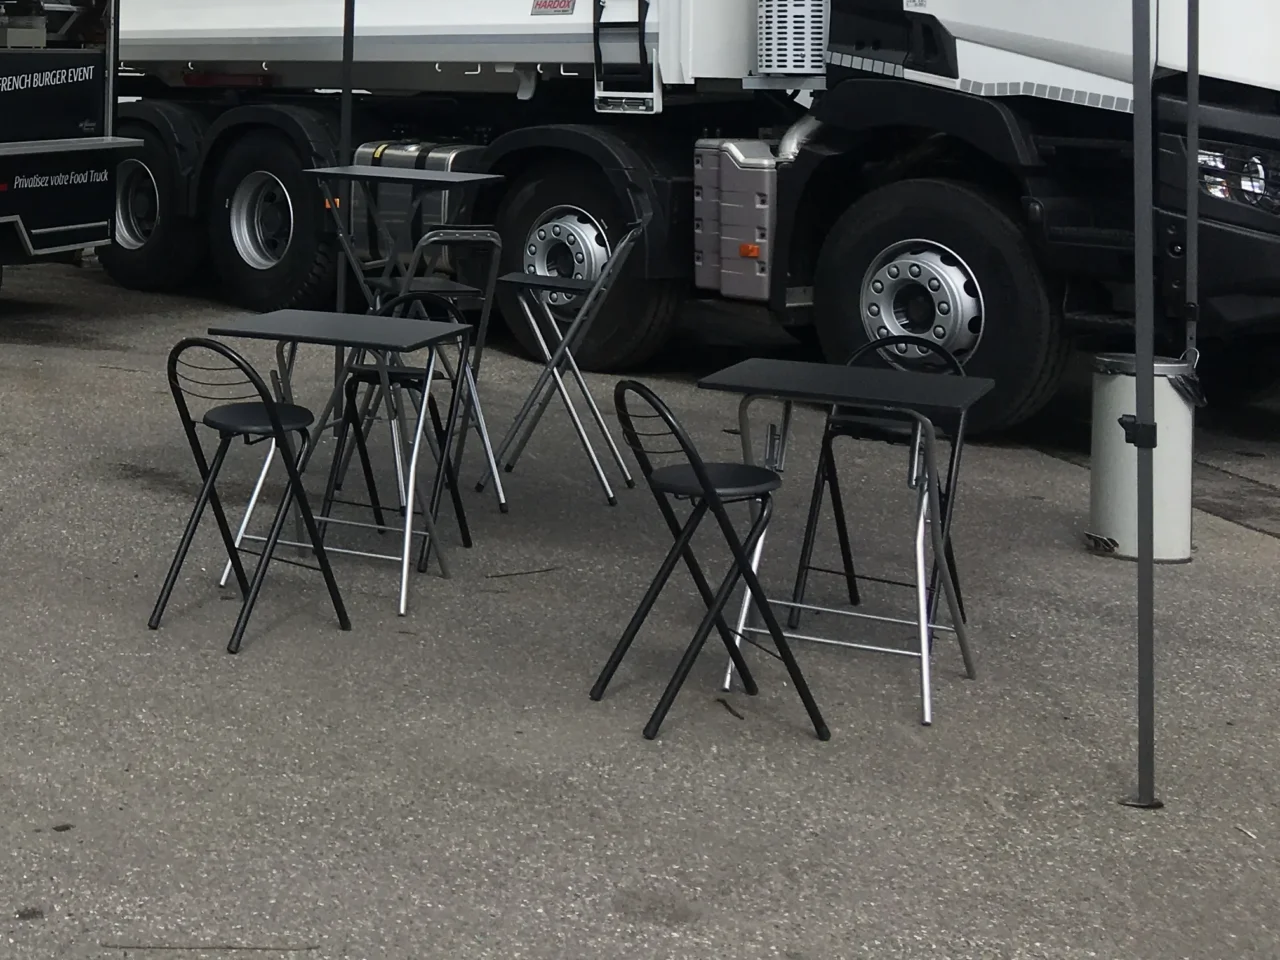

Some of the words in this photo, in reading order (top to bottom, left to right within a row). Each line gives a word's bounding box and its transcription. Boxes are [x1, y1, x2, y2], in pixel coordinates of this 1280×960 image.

[534, 0, 572, 9] HARDOX
[32, 69, 67, 88] BURGER
[67, 65, 95, 83] EVENT
[13, 174, 50, 189] Privatisez
[50, 172, 69, 186] votre
[69, 170, 89, 184] Food
[89, 169, 109, 182] Truck
